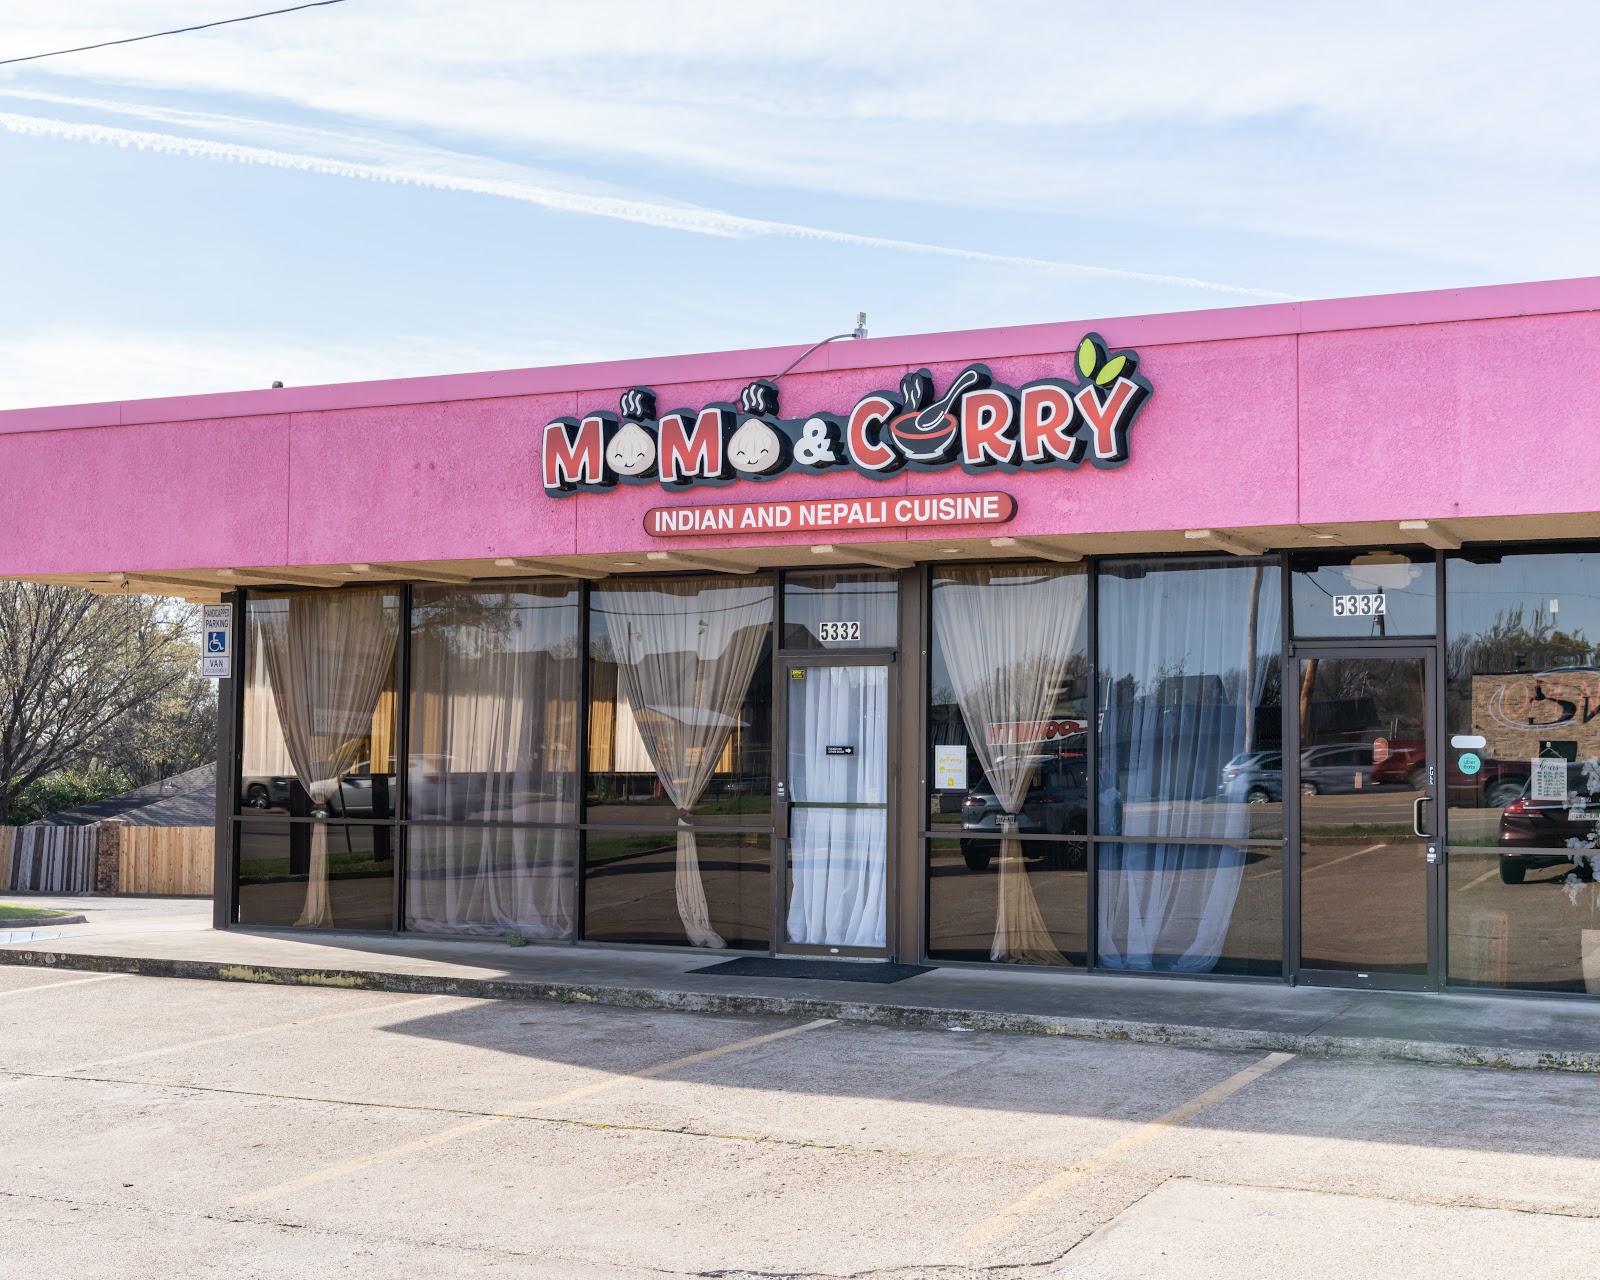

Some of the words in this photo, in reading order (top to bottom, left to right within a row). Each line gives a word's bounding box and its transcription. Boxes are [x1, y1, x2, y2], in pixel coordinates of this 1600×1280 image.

[793, 417, 836, 466] &
[654, 508, 734, 532] INDIAN
[739, 505, 793, 529] AND
[799, 501, 888, 527] NEPALI
[894, 496, 1000, 523] CUISINE
[205, 609, 229, 617] HANDICAPPED
[1335, 595, 1384, 615] 5332
[205, 619, 229, 628] PARKING
[821, 623, 859, 640] 5332
